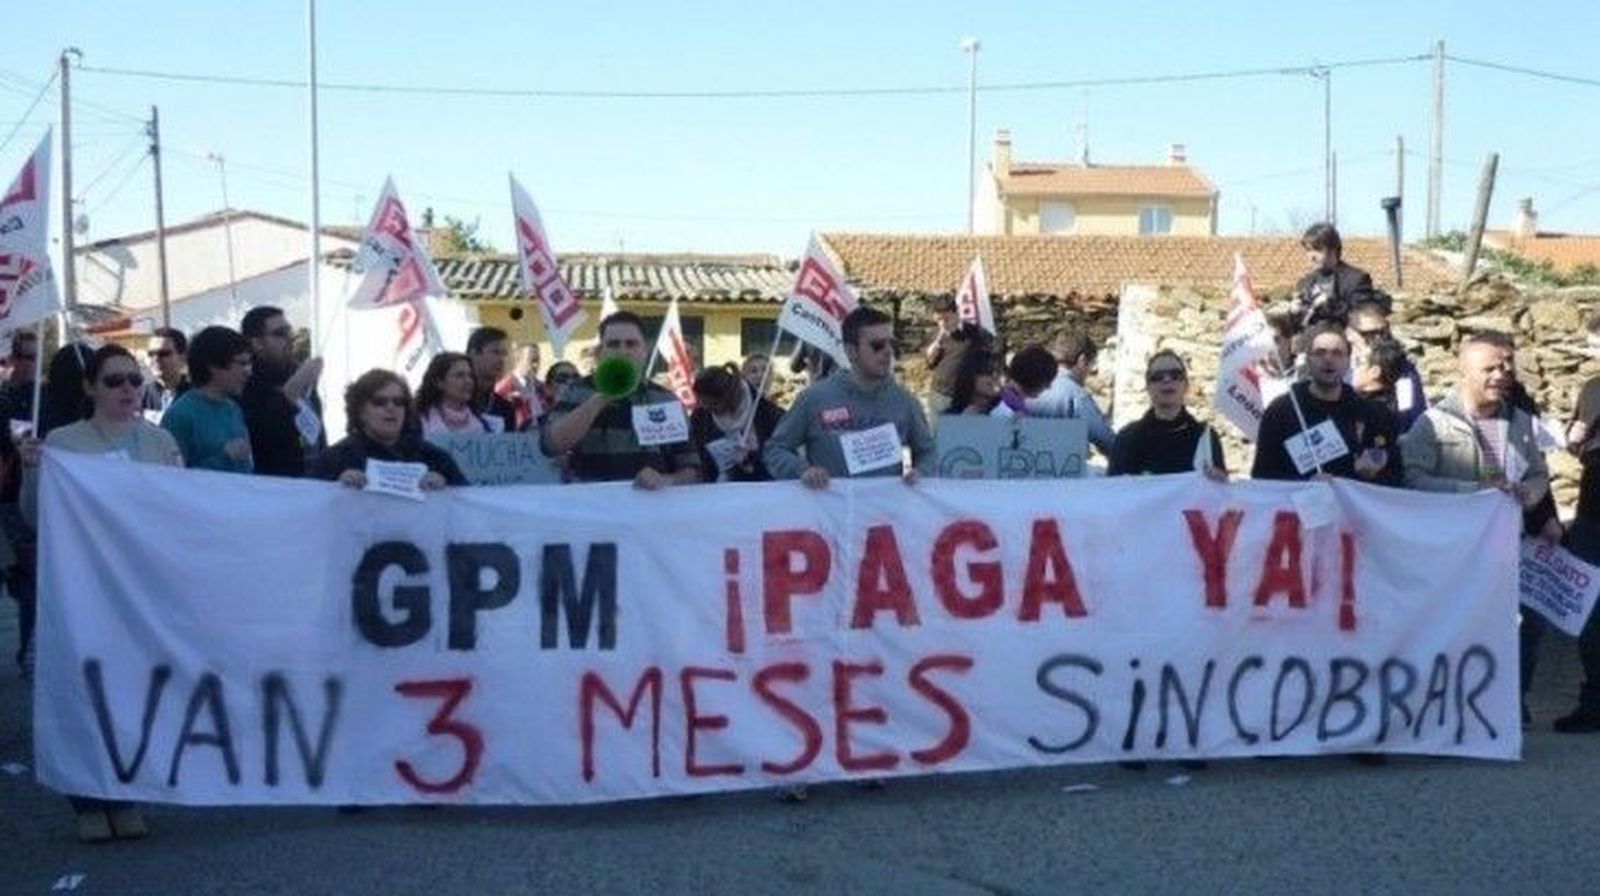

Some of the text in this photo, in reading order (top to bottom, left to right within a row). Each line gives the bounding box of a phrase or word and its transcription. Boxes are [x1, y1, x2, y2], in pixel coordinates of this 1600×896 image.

[351, 509, 1358, 655] GPM ¡PAGA YA!
[83, 658, 345, 789] VAN
[394, 677, 485, 795] 3
[579, 654, 974, 784] MESES
